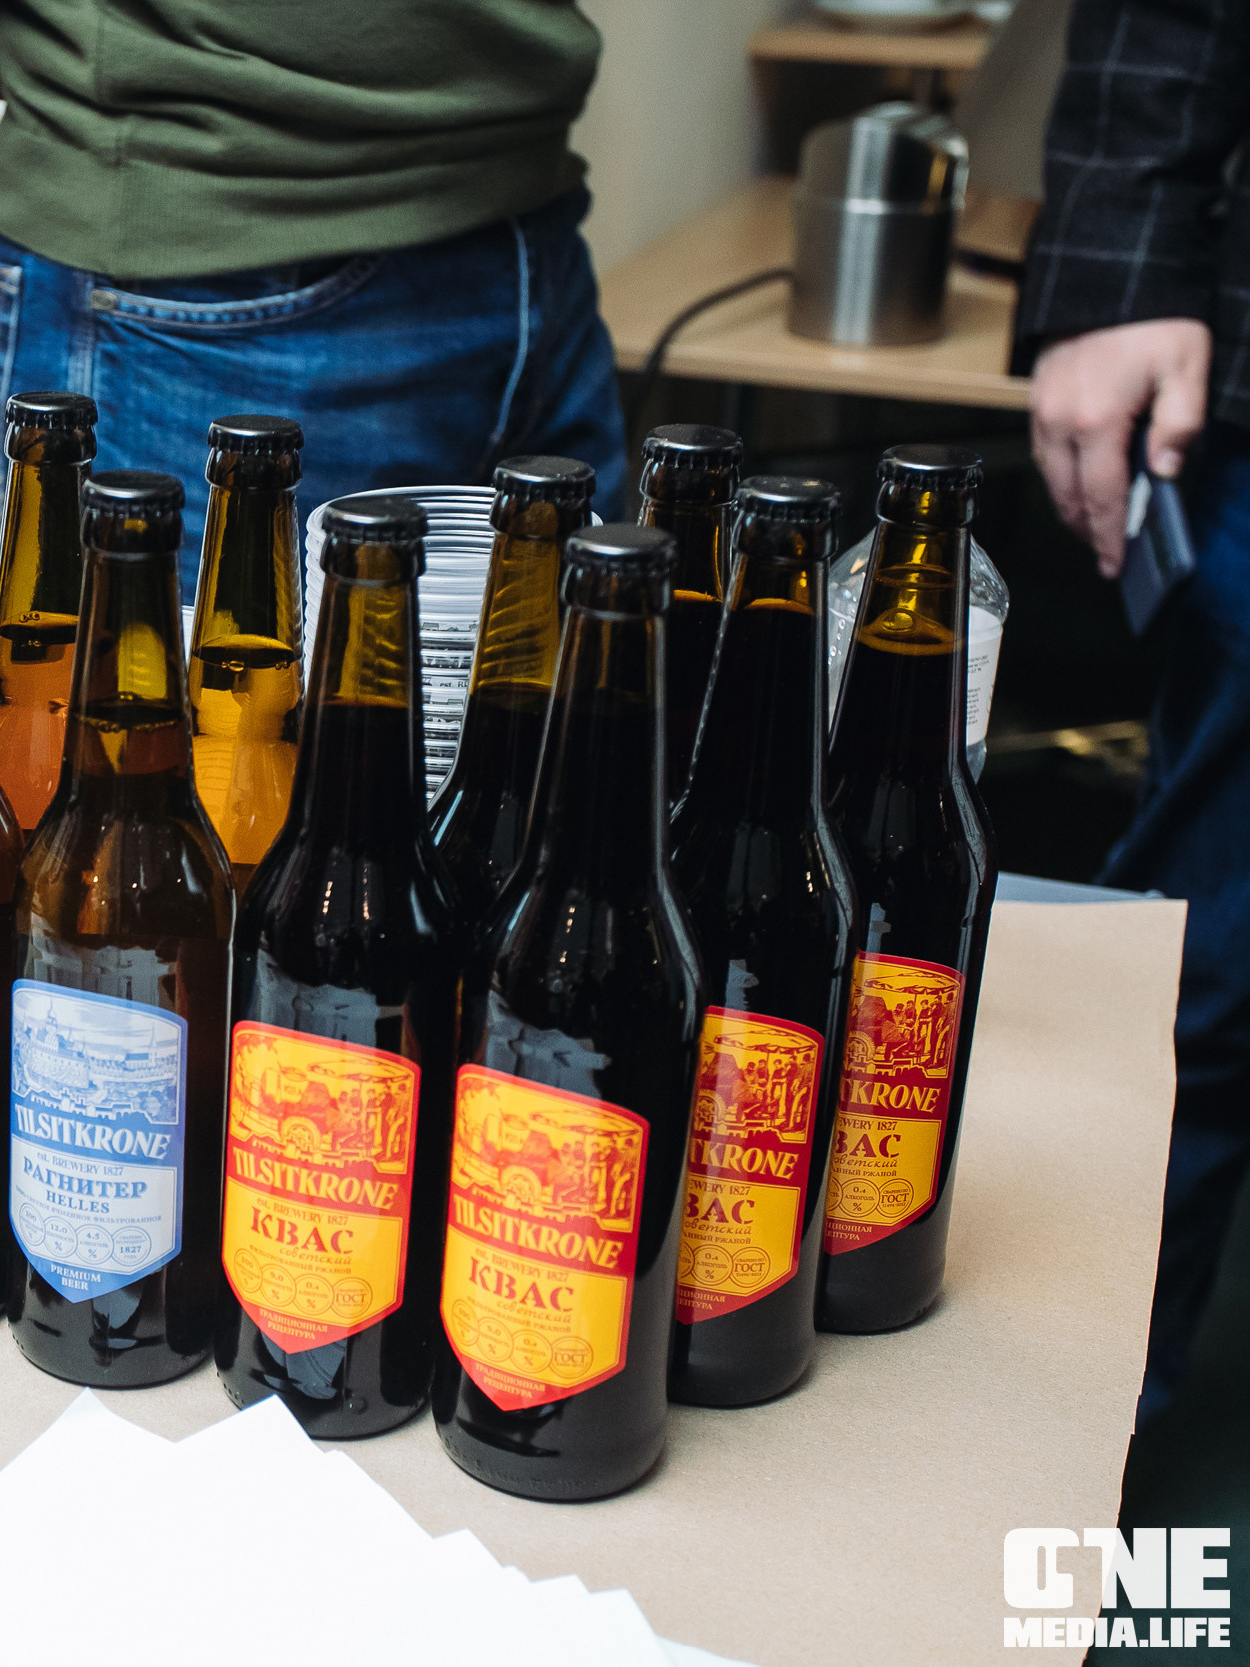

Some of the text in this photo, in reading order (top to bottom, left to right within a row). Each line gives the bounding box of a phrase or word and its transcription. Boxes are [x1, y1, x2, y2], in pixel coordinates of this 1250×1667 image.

[14, 1102, 172, 1160] TILSITKRONE
[877, 1121, 898, 1131] 1827
[836, 1130, 901, 1158] ВАС
[52, 1156, 124, 1176] BREWERY 1827
[833, 1154, 898, 1168] оветский
[23, 1155, 148, 1199] РАГНИТЕР
[232, 1146, 399, 1212] TILSITKRONE
[729, 1186, 751, 1196] 1827
[881, 1193, 909, 1203] ГОСТ
[46, 1190, 110, 1214] HELLES
[686, 1194, 755, 1225] ВАС
[273, 1203, 349, 1226] BREWERY 1827
[251, 1206, 354, 1255] КВАС
[453, 1193, 624, 1270] TILSITKRONE
[685, 1219, 752, 1235] оветский
[119, 1245, 142, 1254] 1827
[50, 1264, 102, 1283] PREMIUM
[734, 1263, 765, 1273] ГОСТ
[61, 1277, 89, 1291] BEER
[469, 1256, 574, 1313] КВАС
[335, 1293, 367, 1303] ГОСТ
